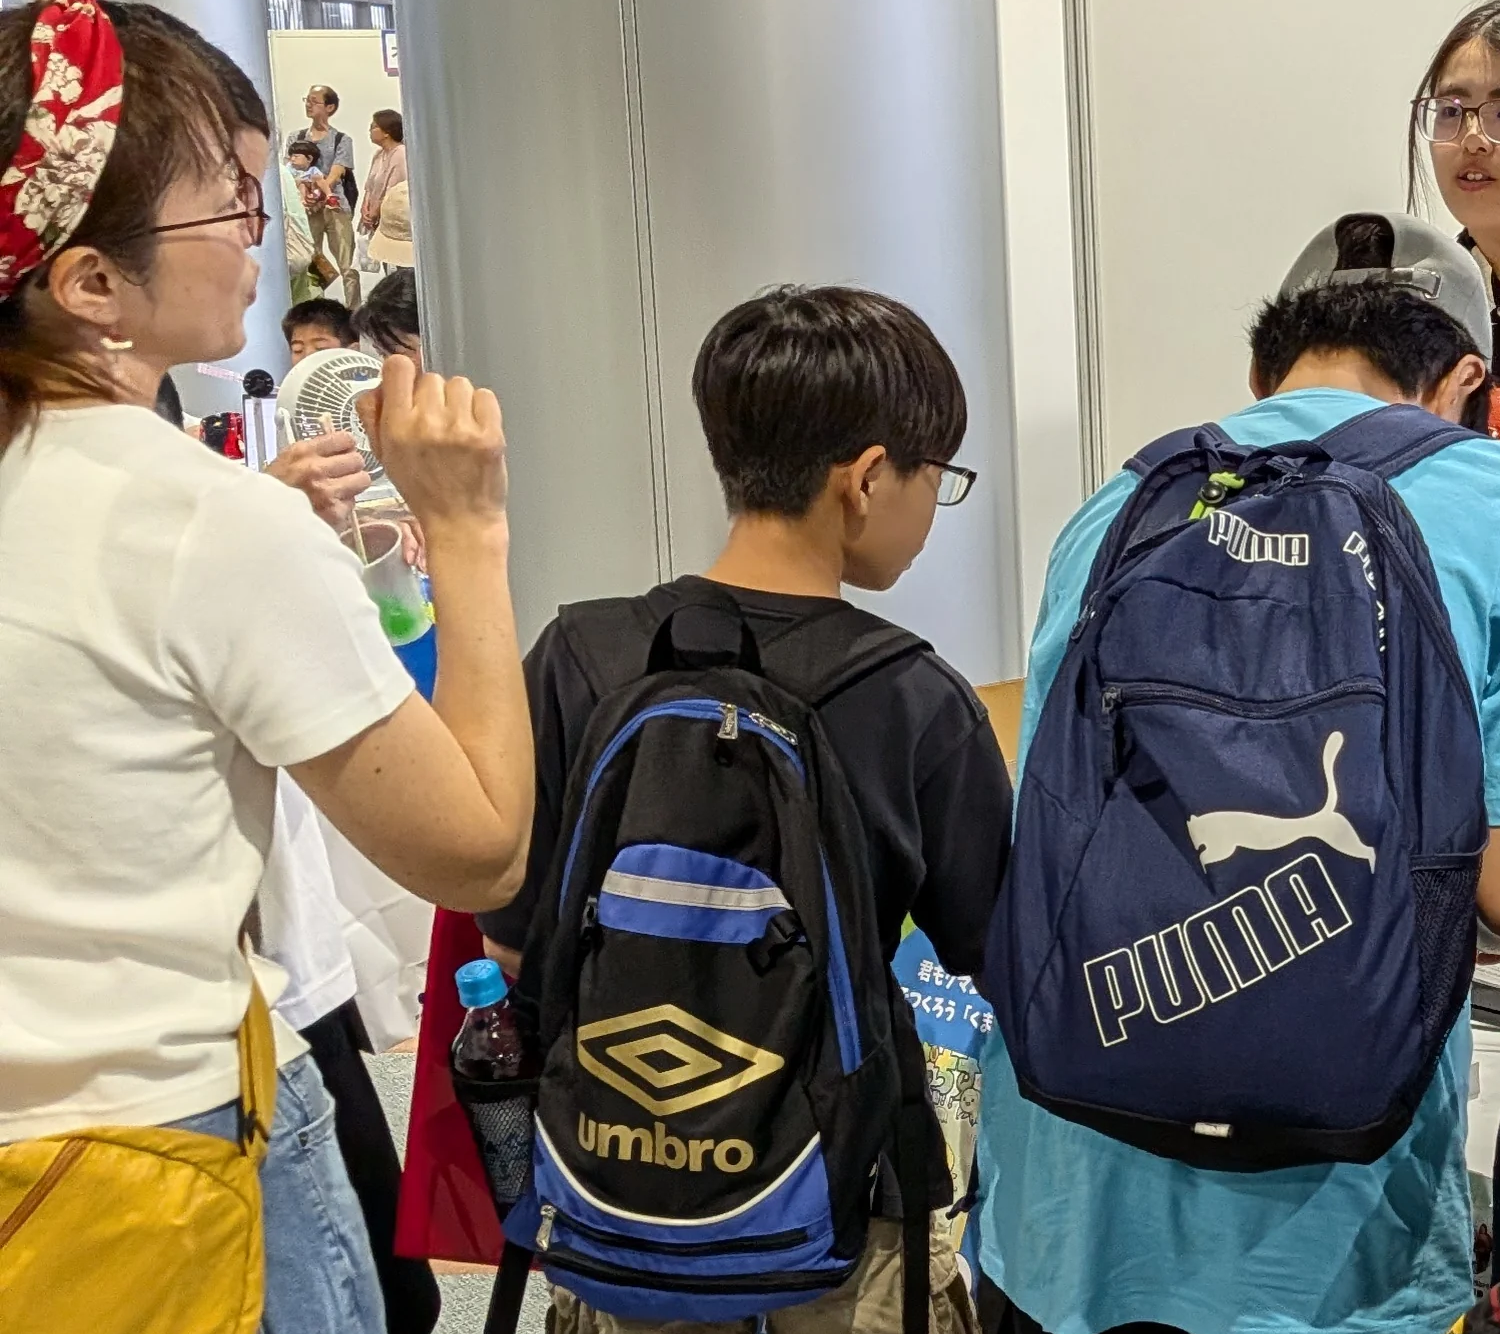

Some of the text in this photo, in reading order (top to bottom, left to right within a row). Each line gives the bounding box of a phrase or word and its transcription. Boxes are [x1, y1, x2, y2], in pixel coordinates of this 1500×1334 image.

[1208, 510, 1309, 566] PUMA
[1083, 852, 1354, 1047] PUMA
[577, 1111, 754, 1173] umbro
